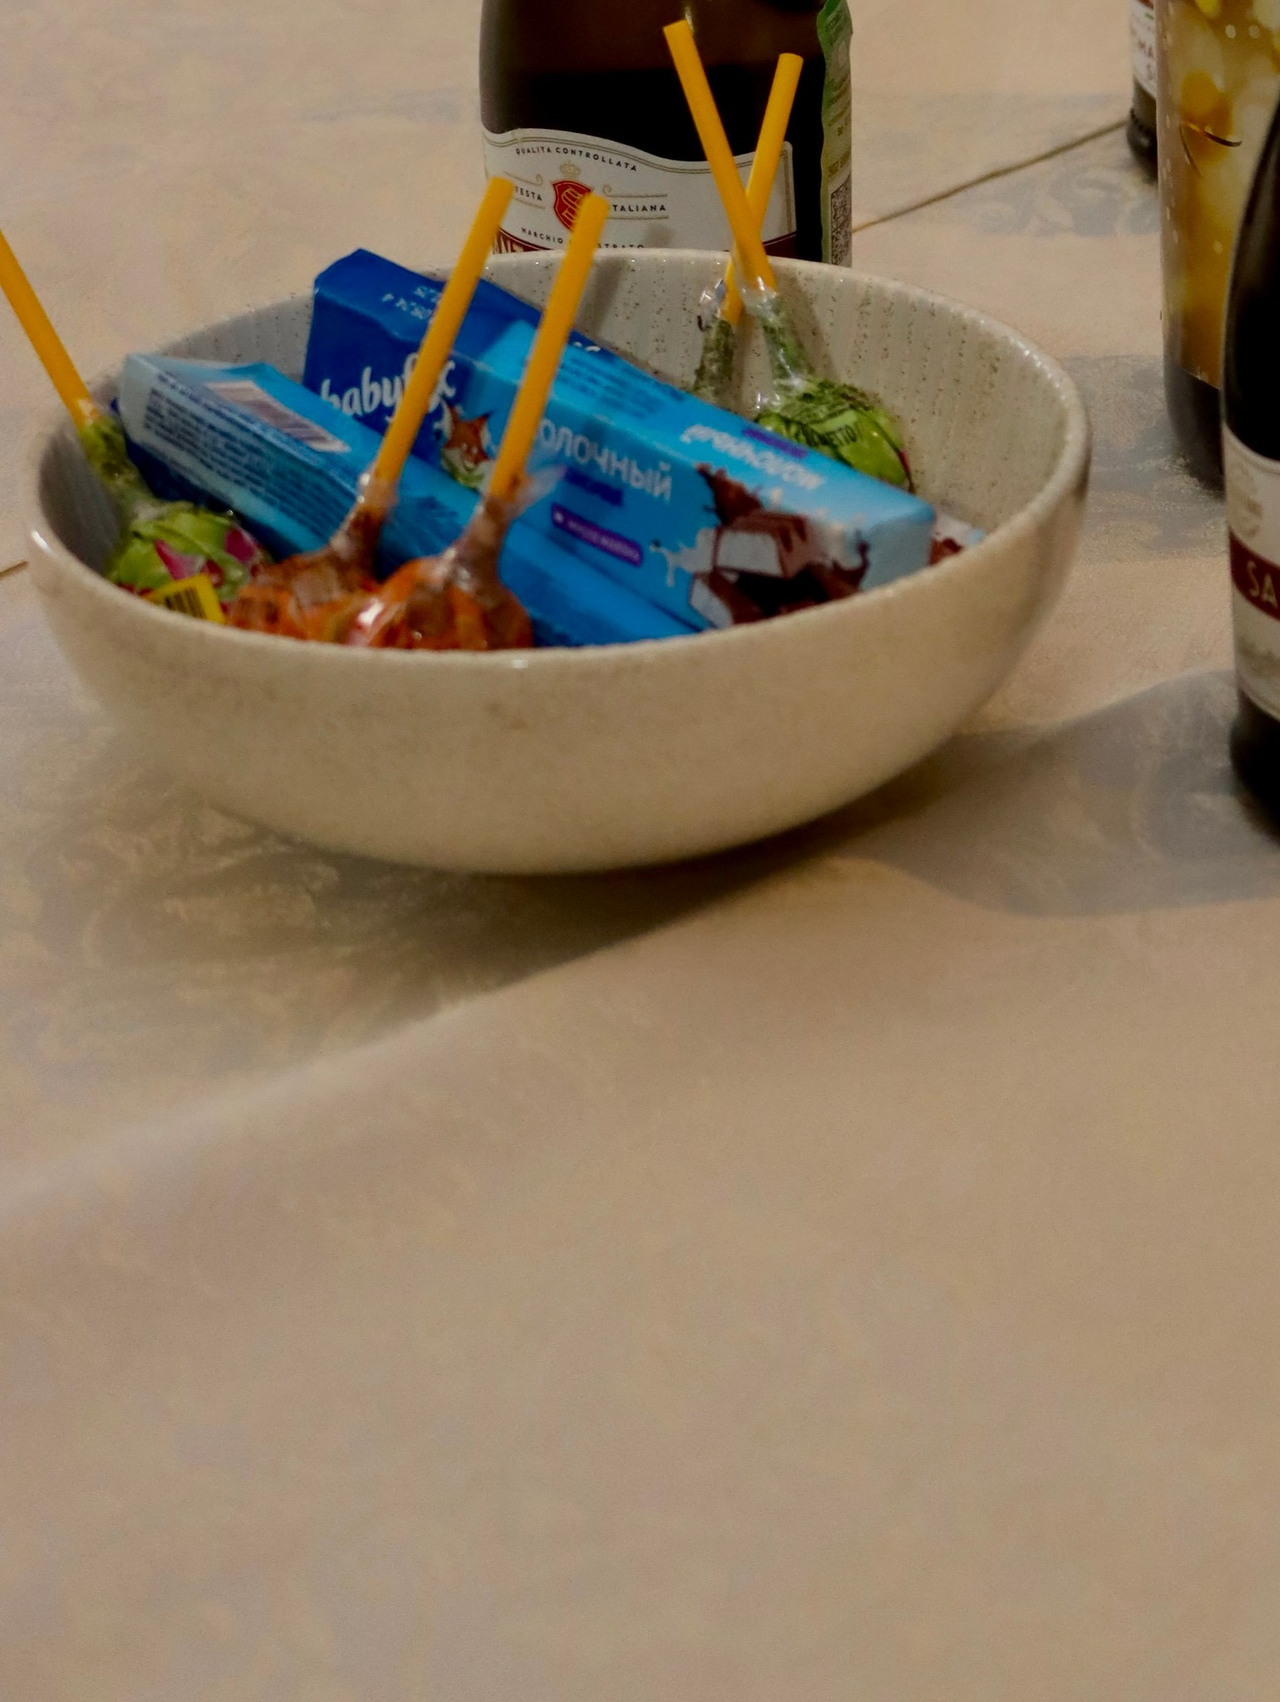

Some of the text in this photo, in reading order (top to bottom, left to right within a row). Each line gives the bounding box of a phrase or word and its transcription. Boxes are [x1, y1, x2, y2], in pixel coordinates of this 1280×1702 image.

[555, 146, 638, 172] CONTROLLATA
[612, 203, 667, 213] TALIANA
[539, 417, 673, 502] олочный
